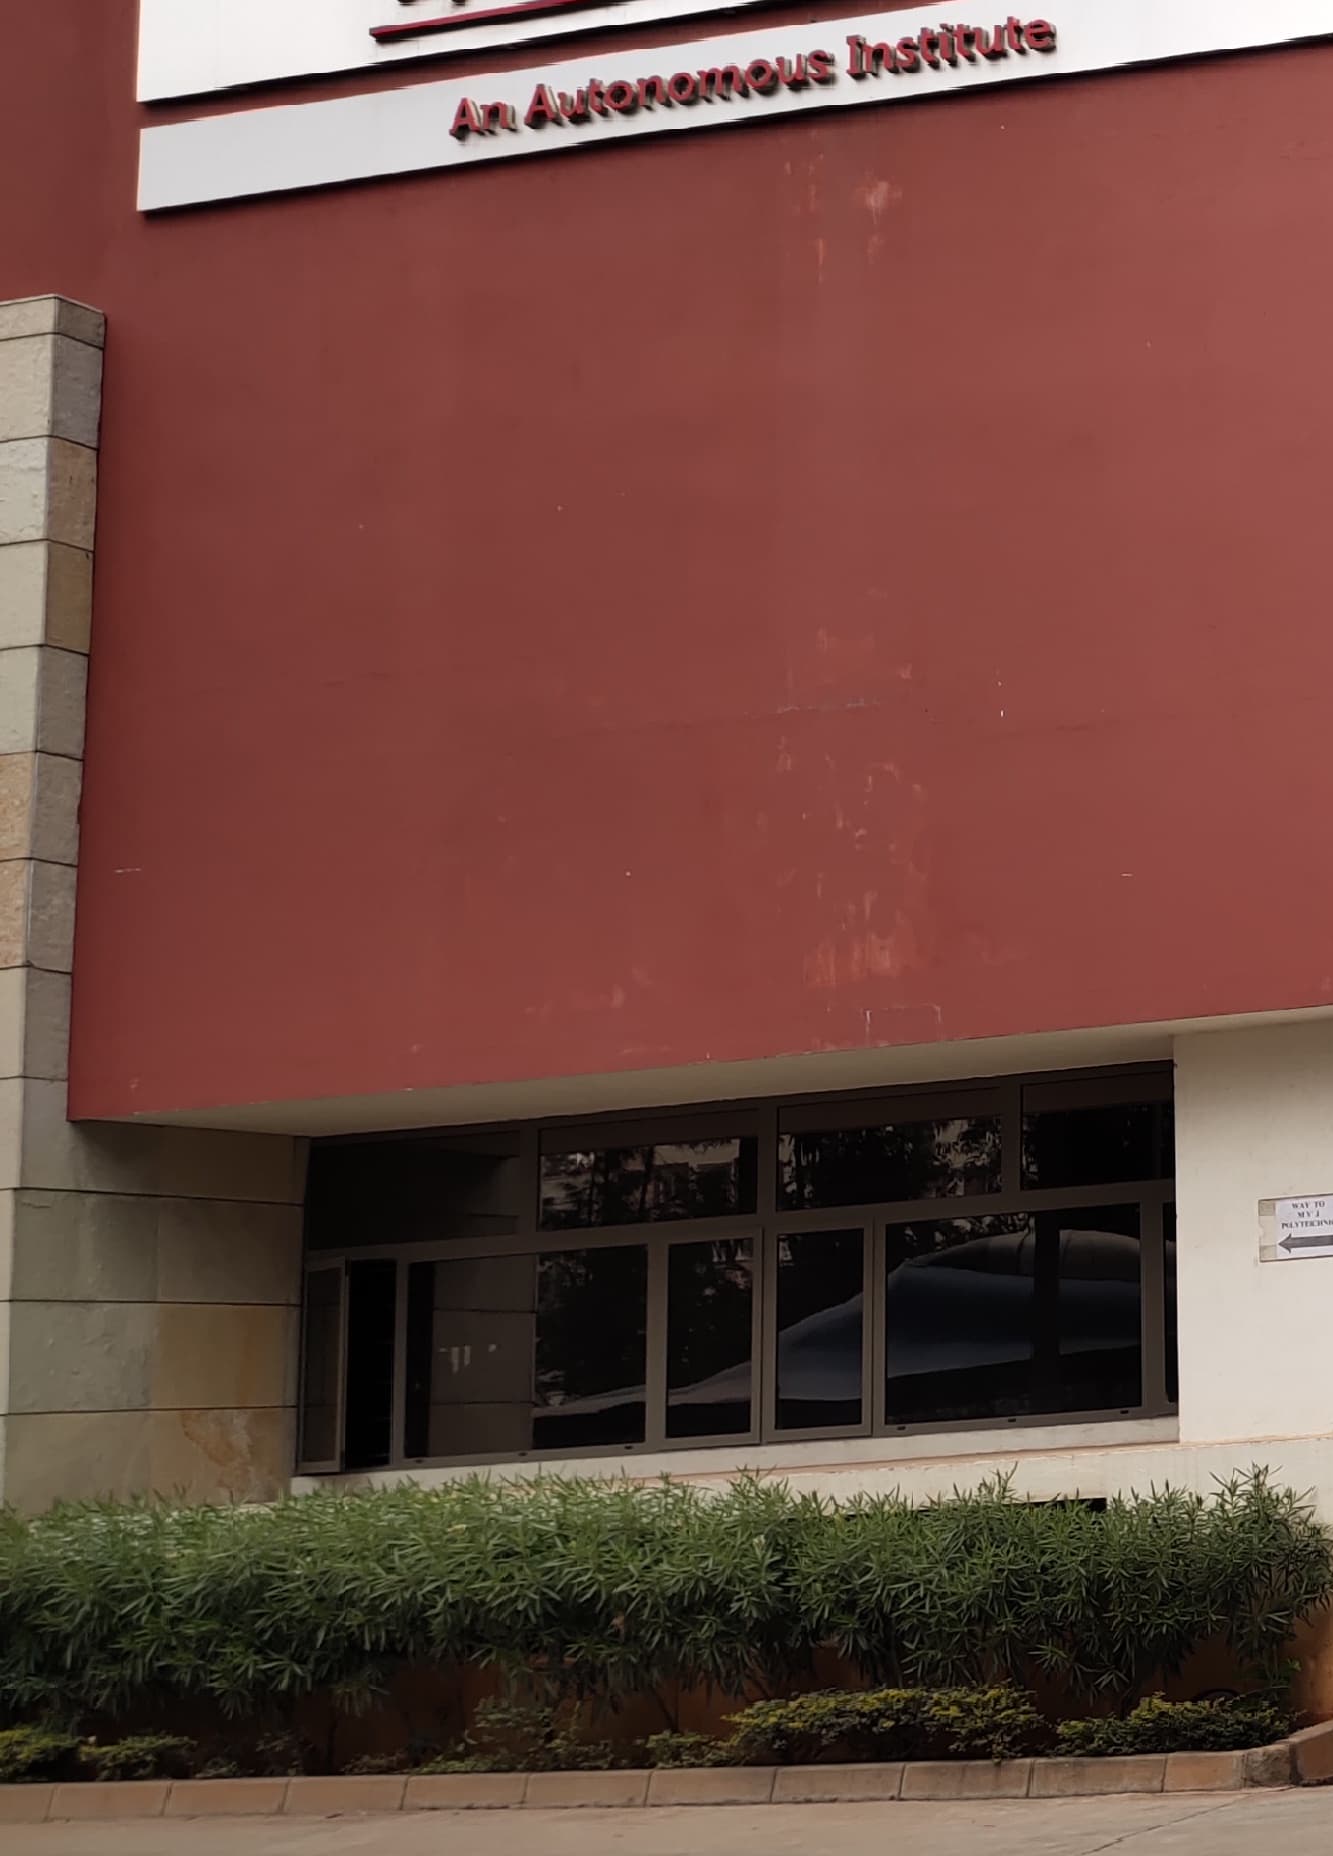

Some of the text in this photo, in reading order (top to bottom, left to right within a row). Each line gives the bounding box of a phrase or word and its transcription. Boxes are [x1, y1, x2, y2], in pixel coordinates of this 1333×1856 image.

[449, 15, 1055, 136] An Autonomous Institute
[1291, 1200, 1326, 1209] WAY TO
